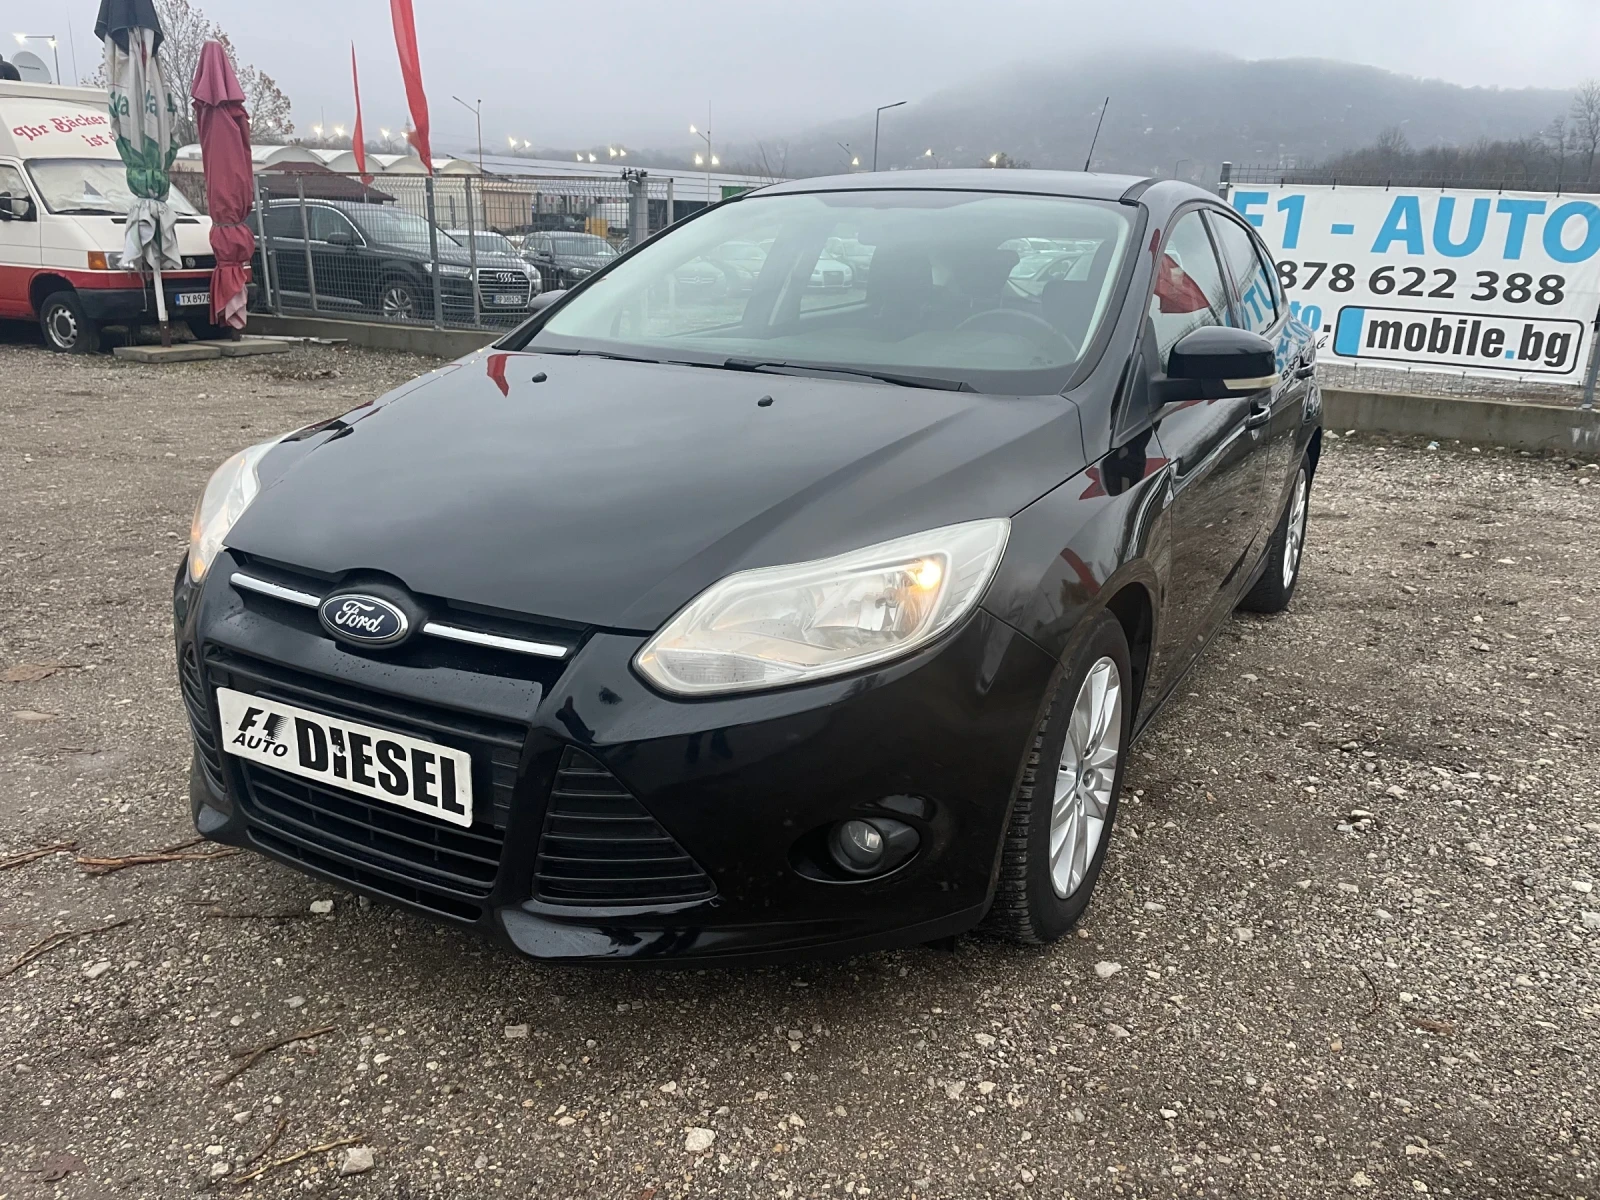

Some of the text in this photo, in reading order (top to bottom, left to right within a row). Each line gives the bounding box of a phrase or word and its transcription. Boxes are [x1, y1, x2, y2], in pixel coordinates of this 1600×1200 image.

[13, 114, 108, 141] Ihr Bäcker
[81, 134, 109, 147] ist
[1371, 195, 1600, 264] AUTO
[1368, 265, 1457, 299] 622
[1470, 270, 1566, 306] 388
[1365, 317, 1572, 368] mobile.bg
[335, 600, 385, 633] Ford
[232, 732, 289, 758] AUTO
[294, 716, 465, 816] DIESEL
